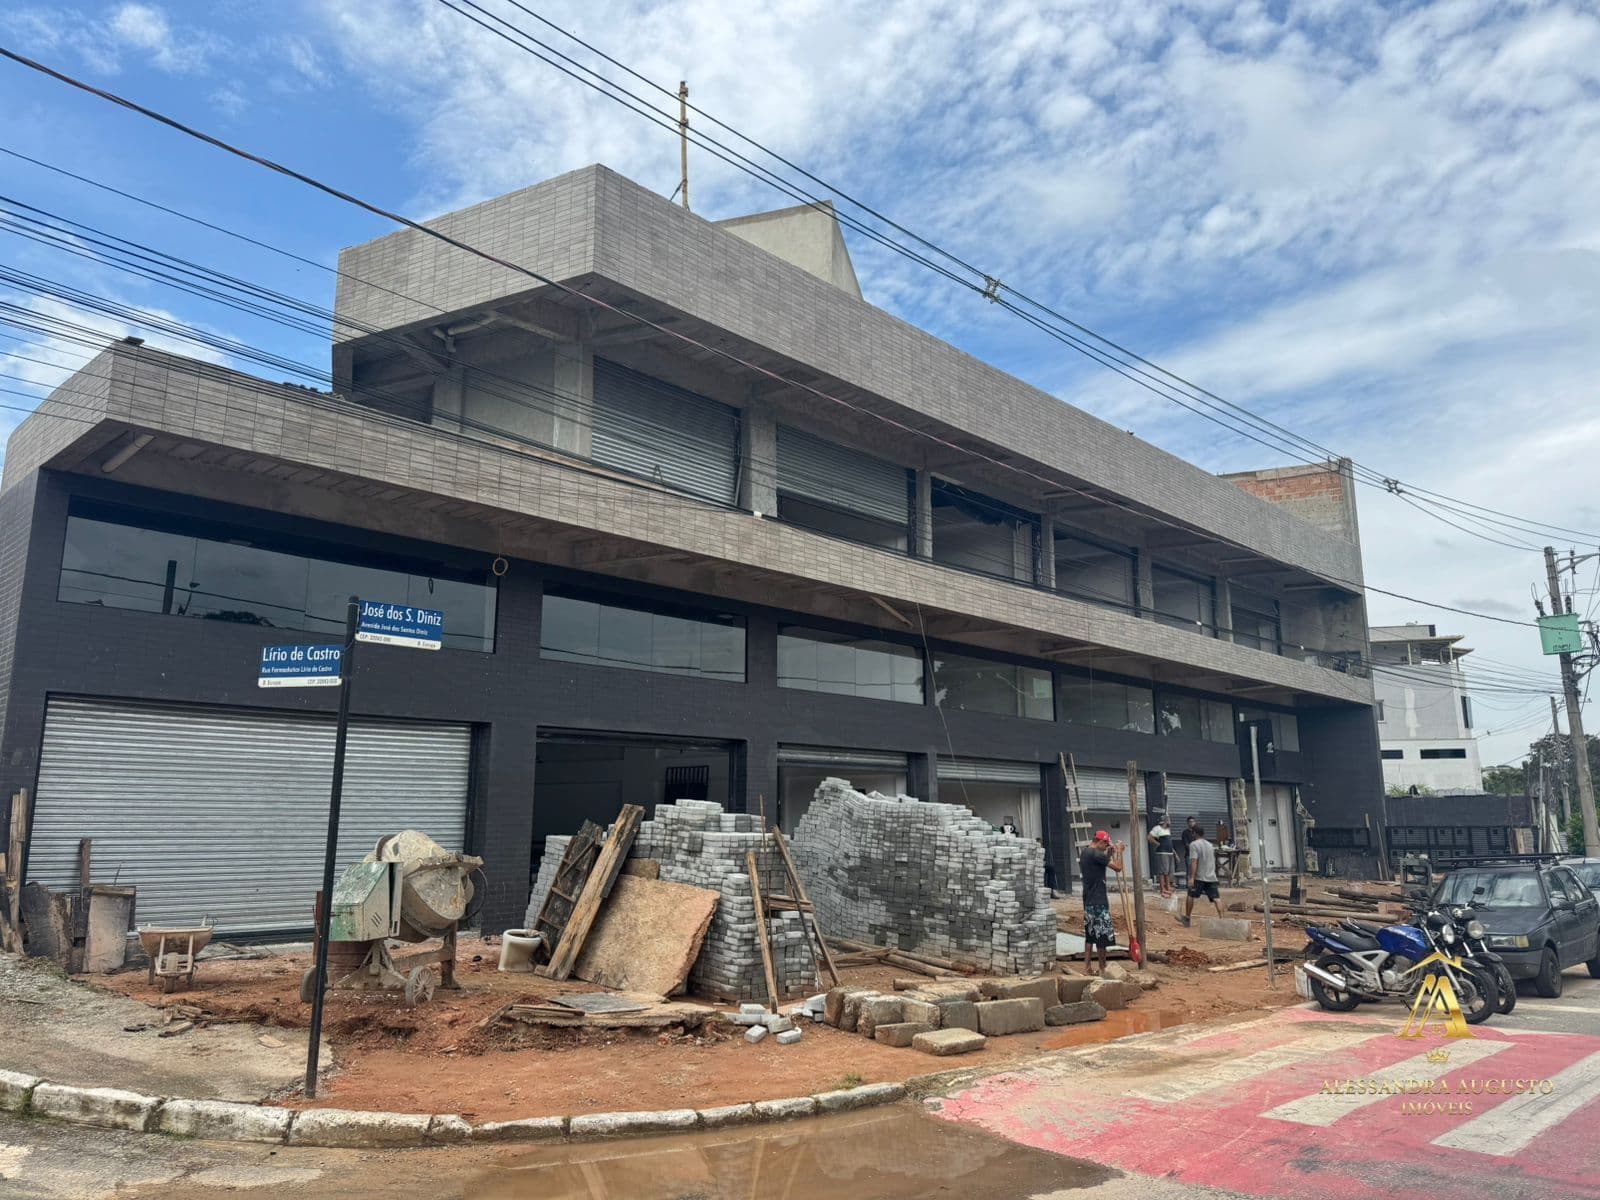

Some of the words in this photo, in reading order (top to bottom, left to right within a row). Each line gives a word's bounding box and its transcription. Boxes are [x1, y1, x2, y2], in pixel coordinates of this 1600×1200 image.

[362, 602, 384, 618] José
[386, 605, 403, 621] dos
[405, 608, 414, 623] S.
[417, 610, 442, 626] Diniz
[262, 647, 288, 662] Lírio
[290, 646, 304, 661] de
[307, 646, 340, 661] Castro
